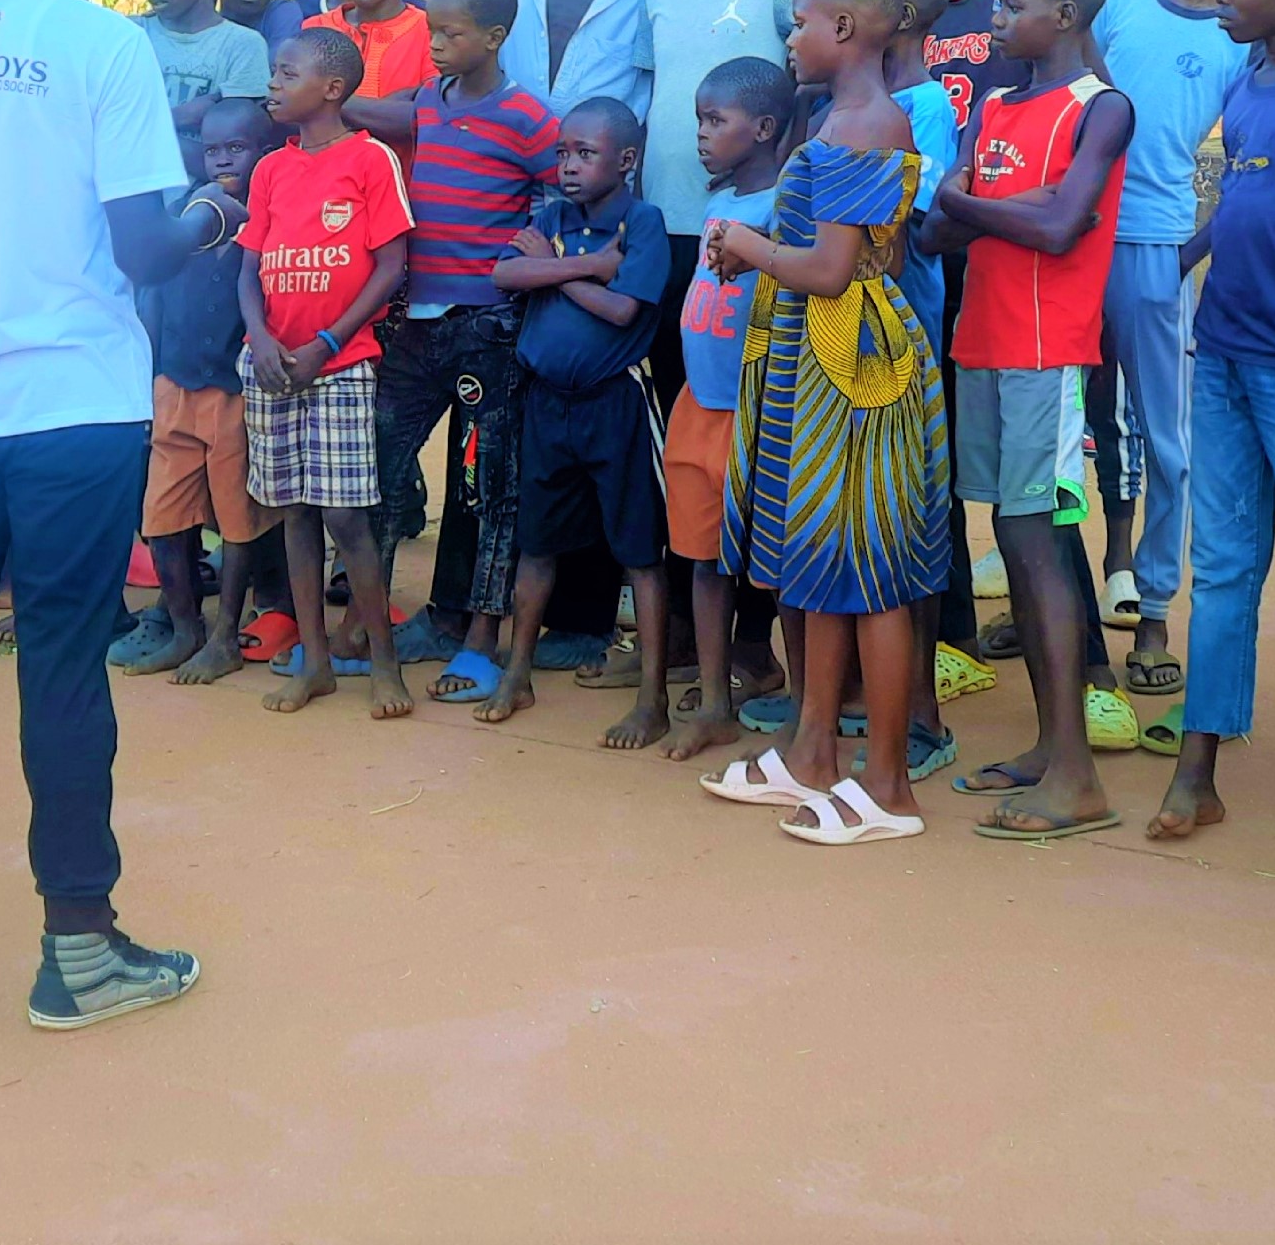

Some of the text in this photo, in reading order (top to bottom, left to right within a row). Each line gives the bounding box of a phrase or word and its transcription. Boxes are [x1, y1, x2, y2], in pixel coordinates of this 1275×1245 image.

[3, 79, 50, 98] SOCIETY
[261, 243, 351, 271] mirates
[278, 271, 331, 294] BETTER
